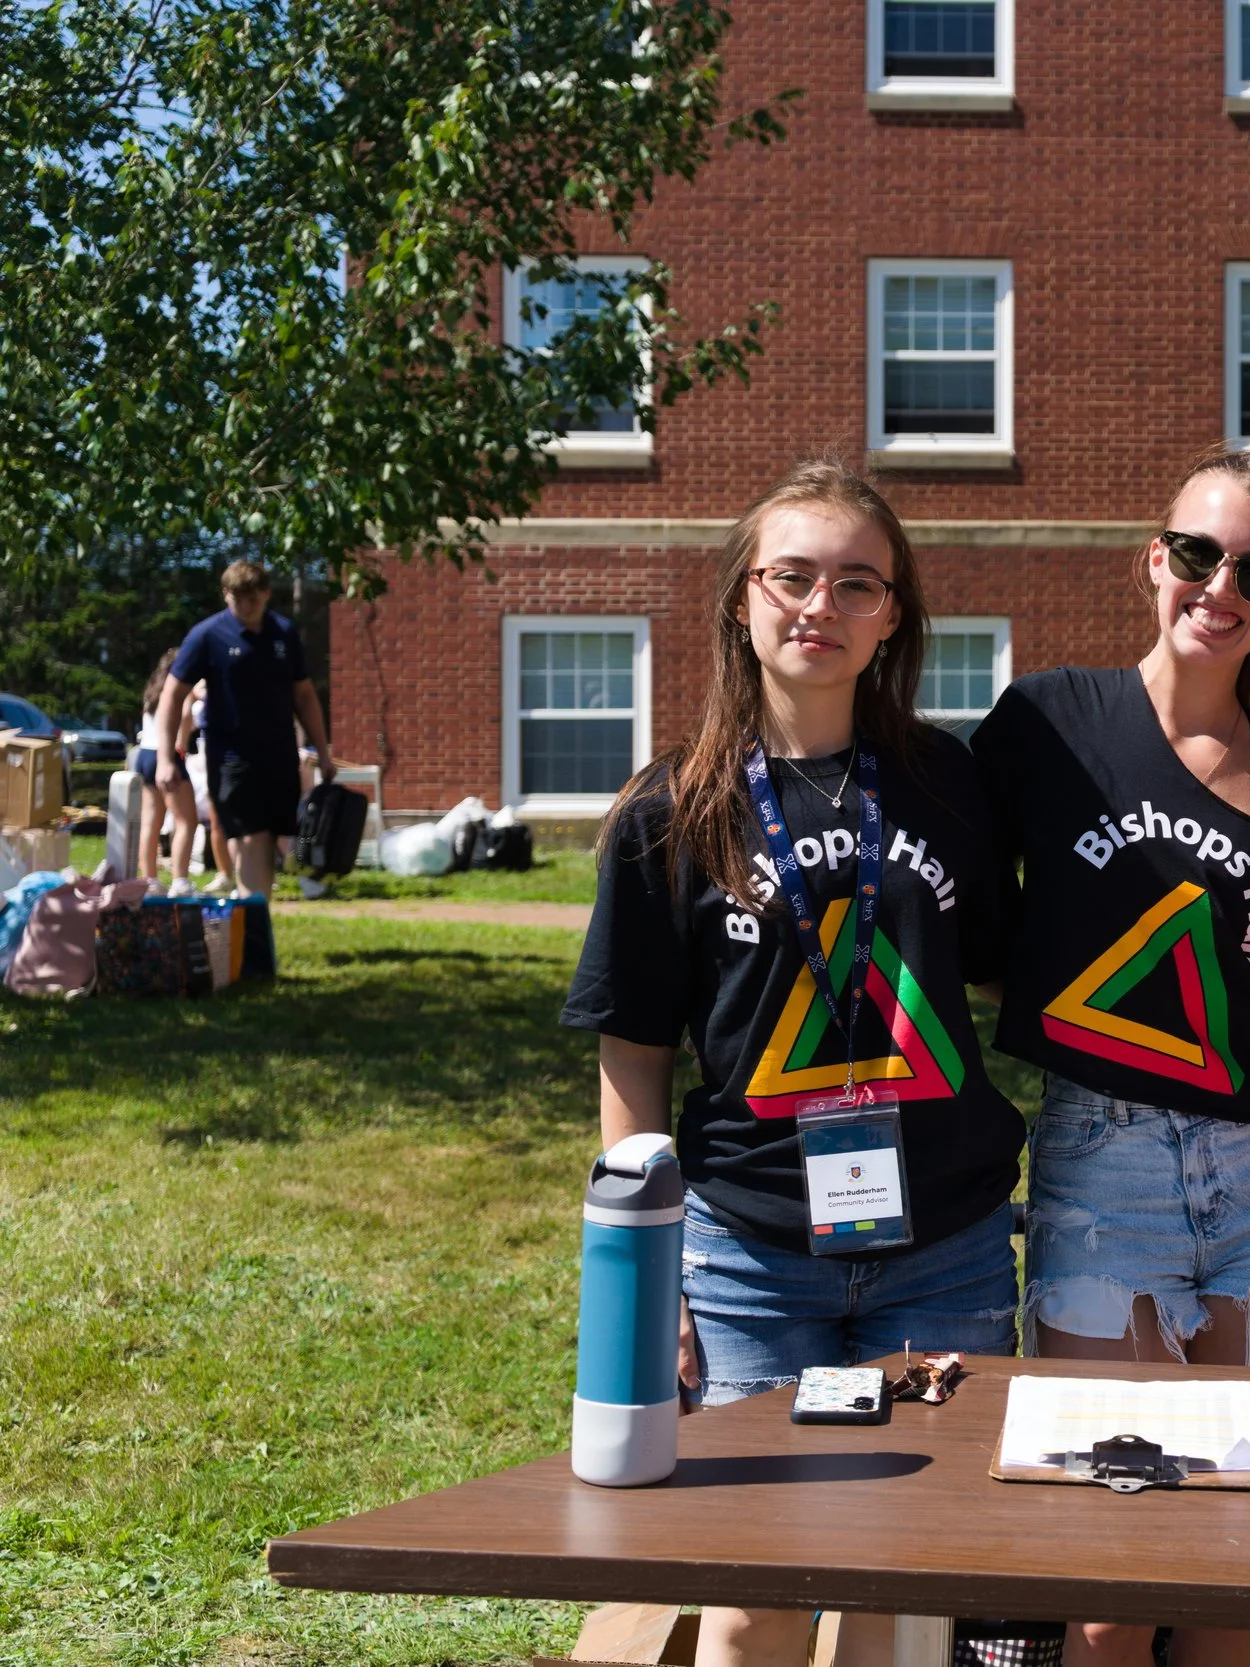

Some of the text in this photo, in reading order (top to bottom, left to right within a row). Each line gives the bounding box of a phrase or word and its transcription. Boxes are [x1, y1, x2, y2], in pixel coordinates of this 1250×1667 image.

[888, 829, 956, 912] Hall
[828, 1186, 887, 1198] Ellen Rudderham
[828, 1199, 864, 1208] Community
